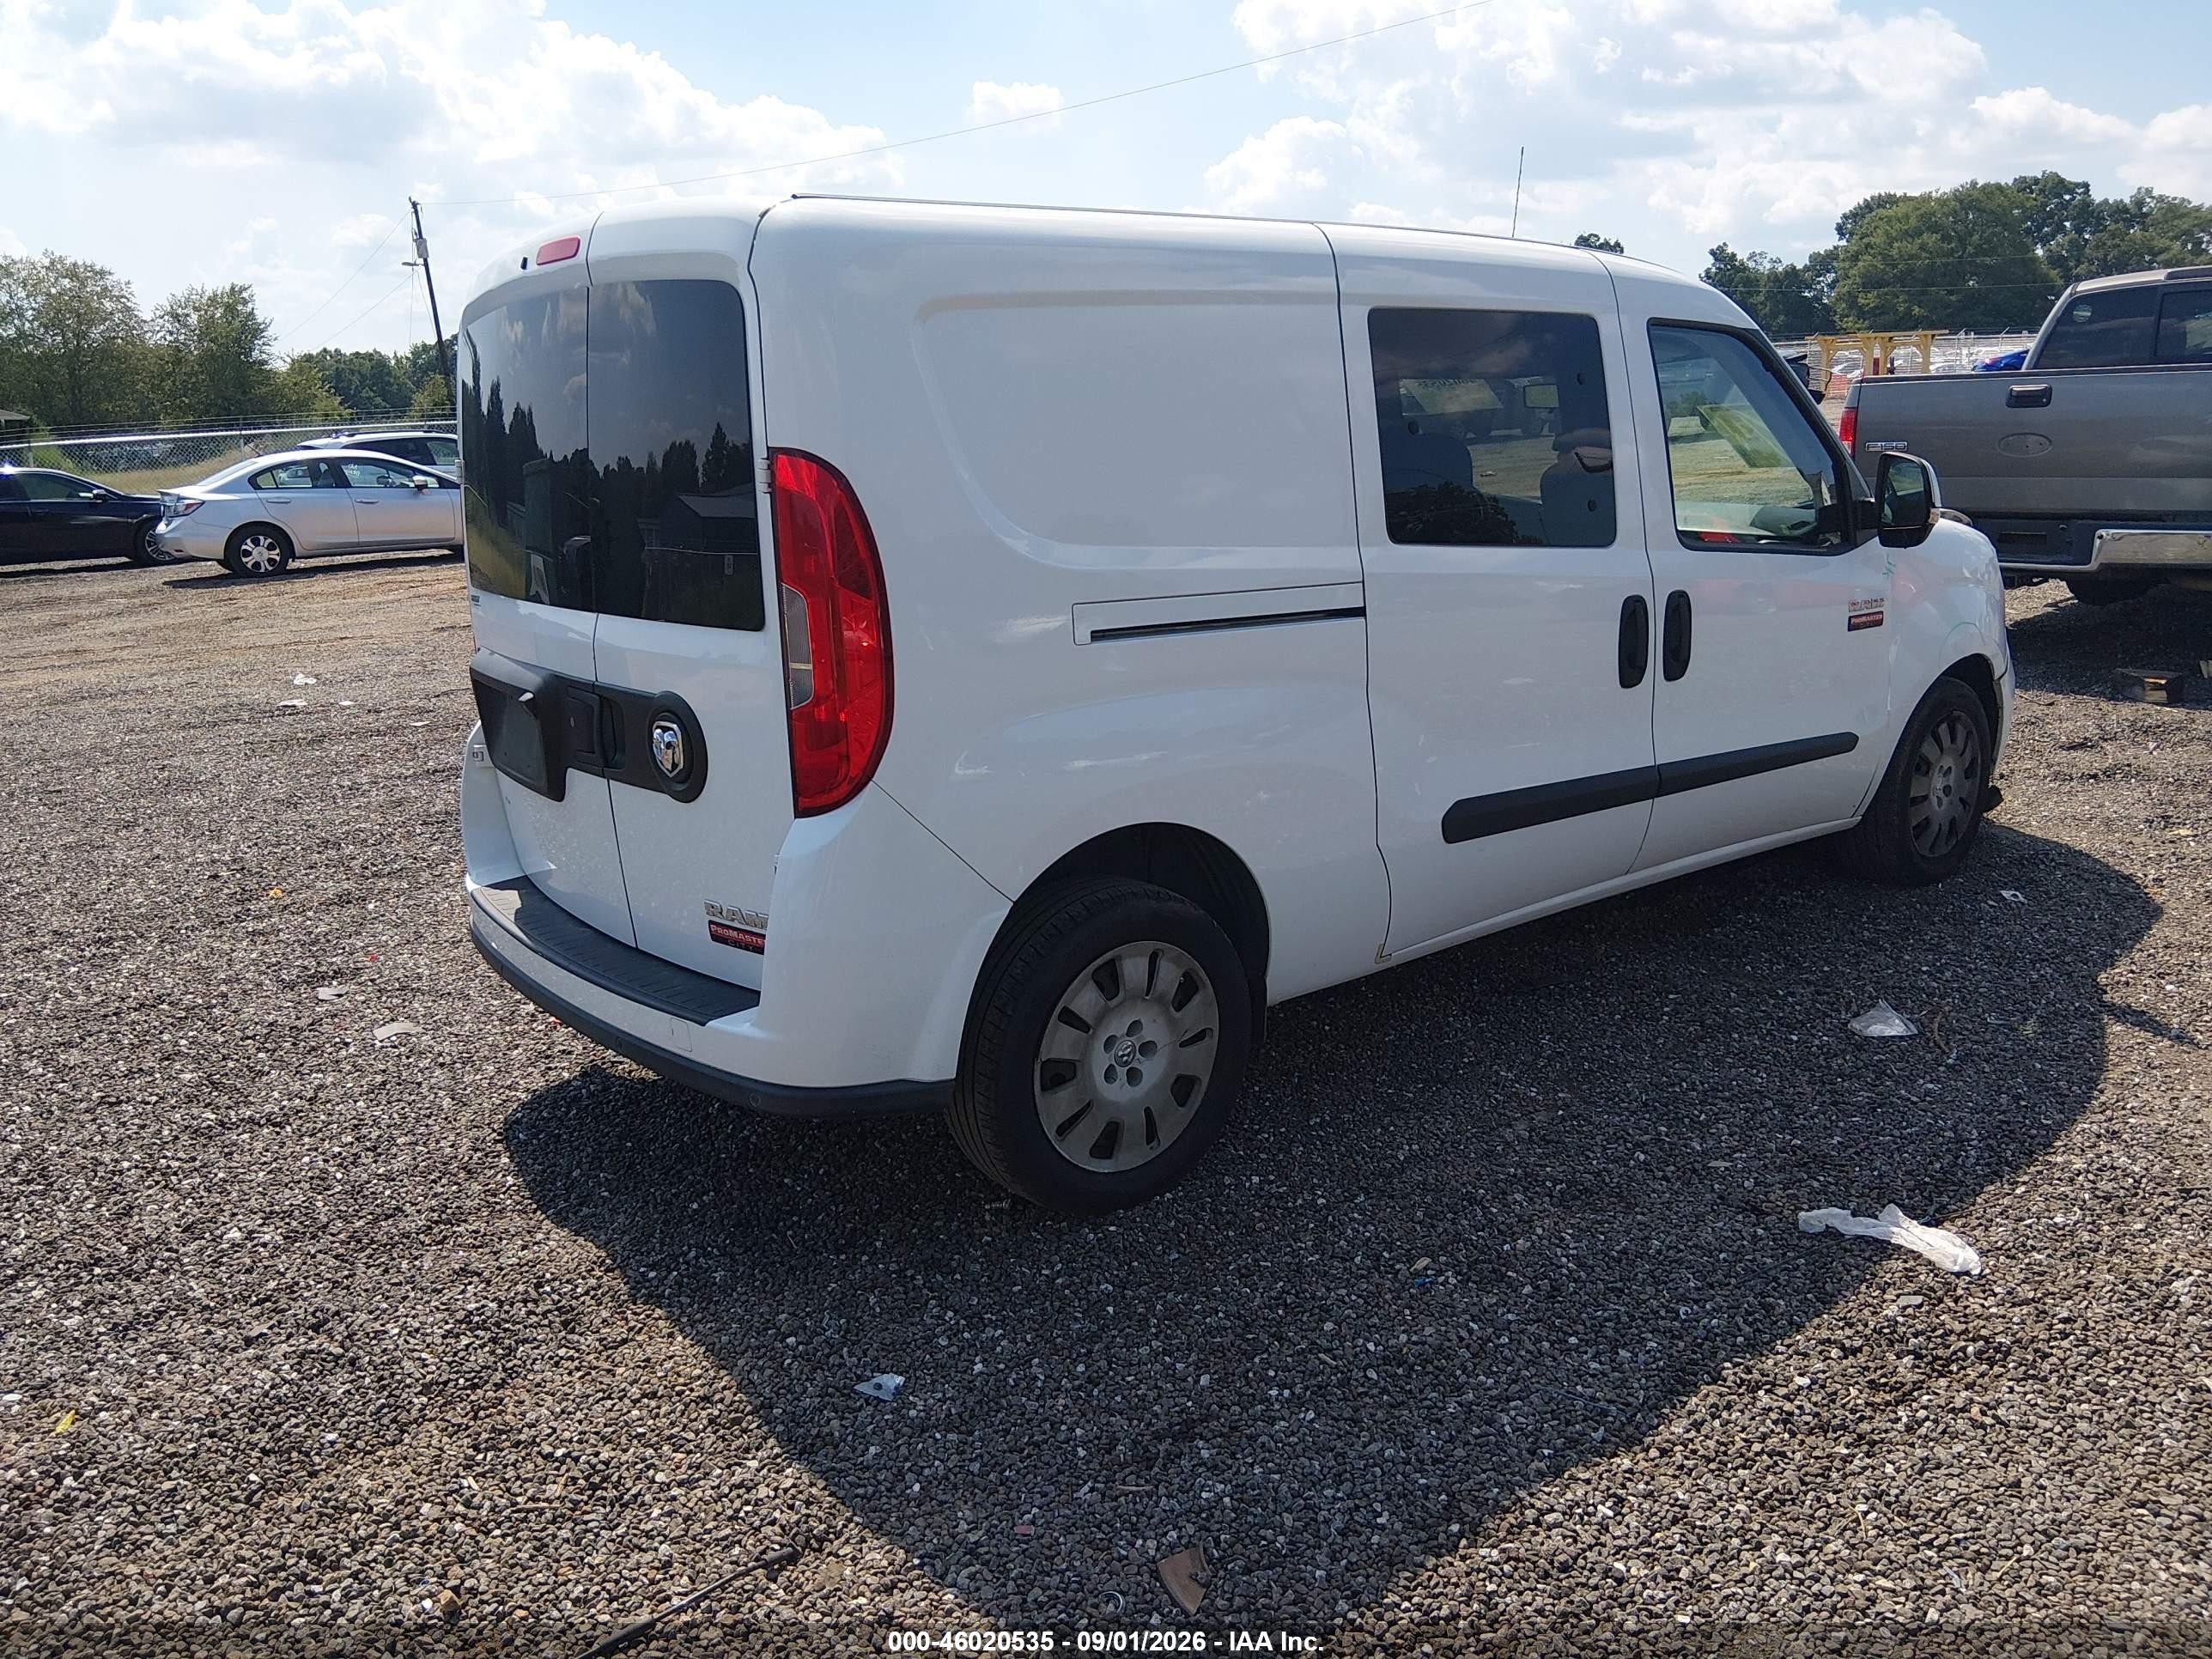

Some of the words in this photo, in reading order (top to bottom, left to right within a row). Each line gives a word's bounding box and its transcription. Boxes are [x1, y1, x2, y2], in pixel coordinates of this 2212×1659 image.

[703, 899, 769, 931] RAM
[709, 925, 766, 945] PROMASTE
[727, 939, 754, 951] CITY
